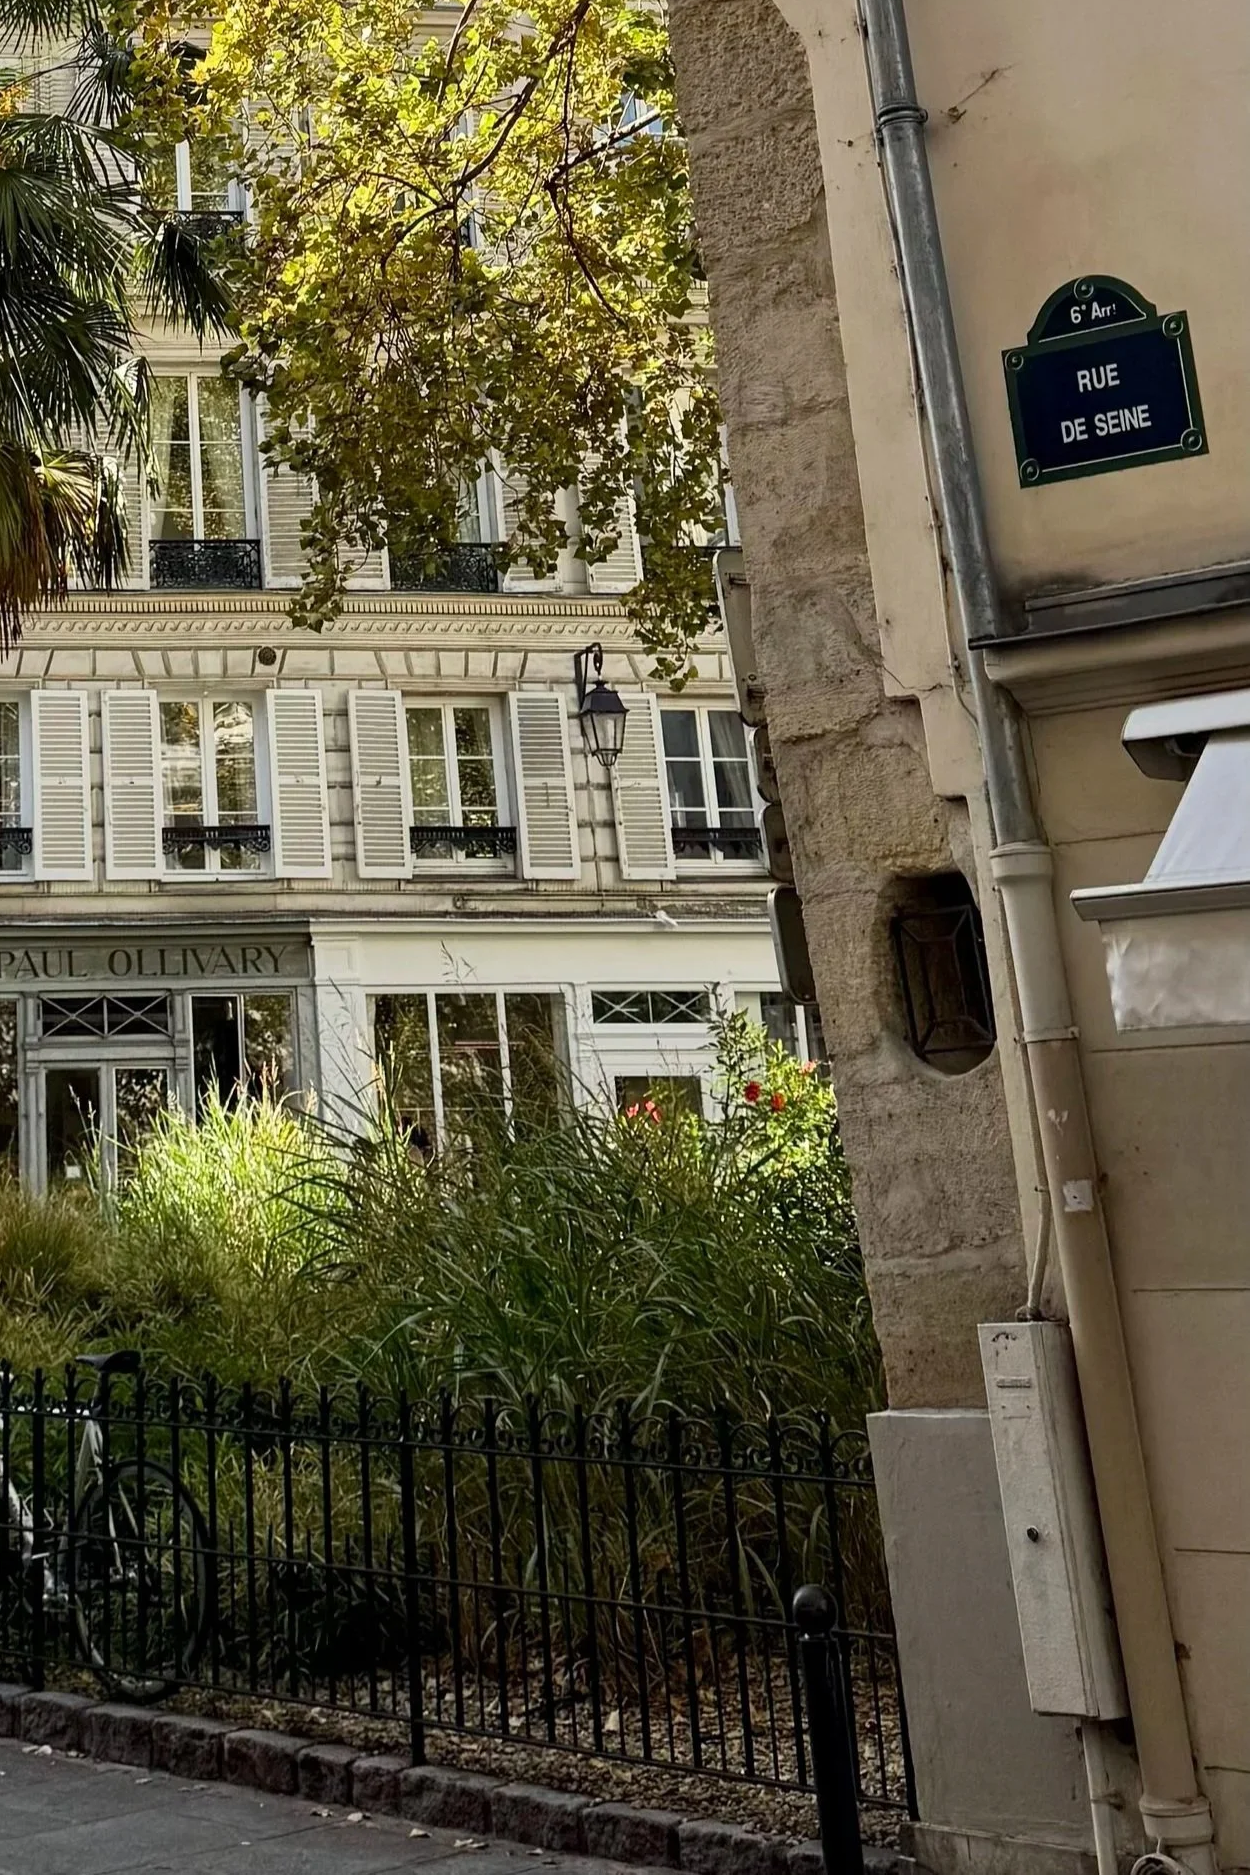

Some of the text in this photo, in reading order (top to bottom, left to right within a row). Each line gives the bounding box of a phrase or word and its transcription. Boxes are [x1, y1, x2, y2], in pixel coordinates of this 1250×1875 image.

[1077, 363, 1120, 393] RUE
[1061, 405, 1152, 444] DE SEINE
[108, 946, 286, 976] OLLIVARY
